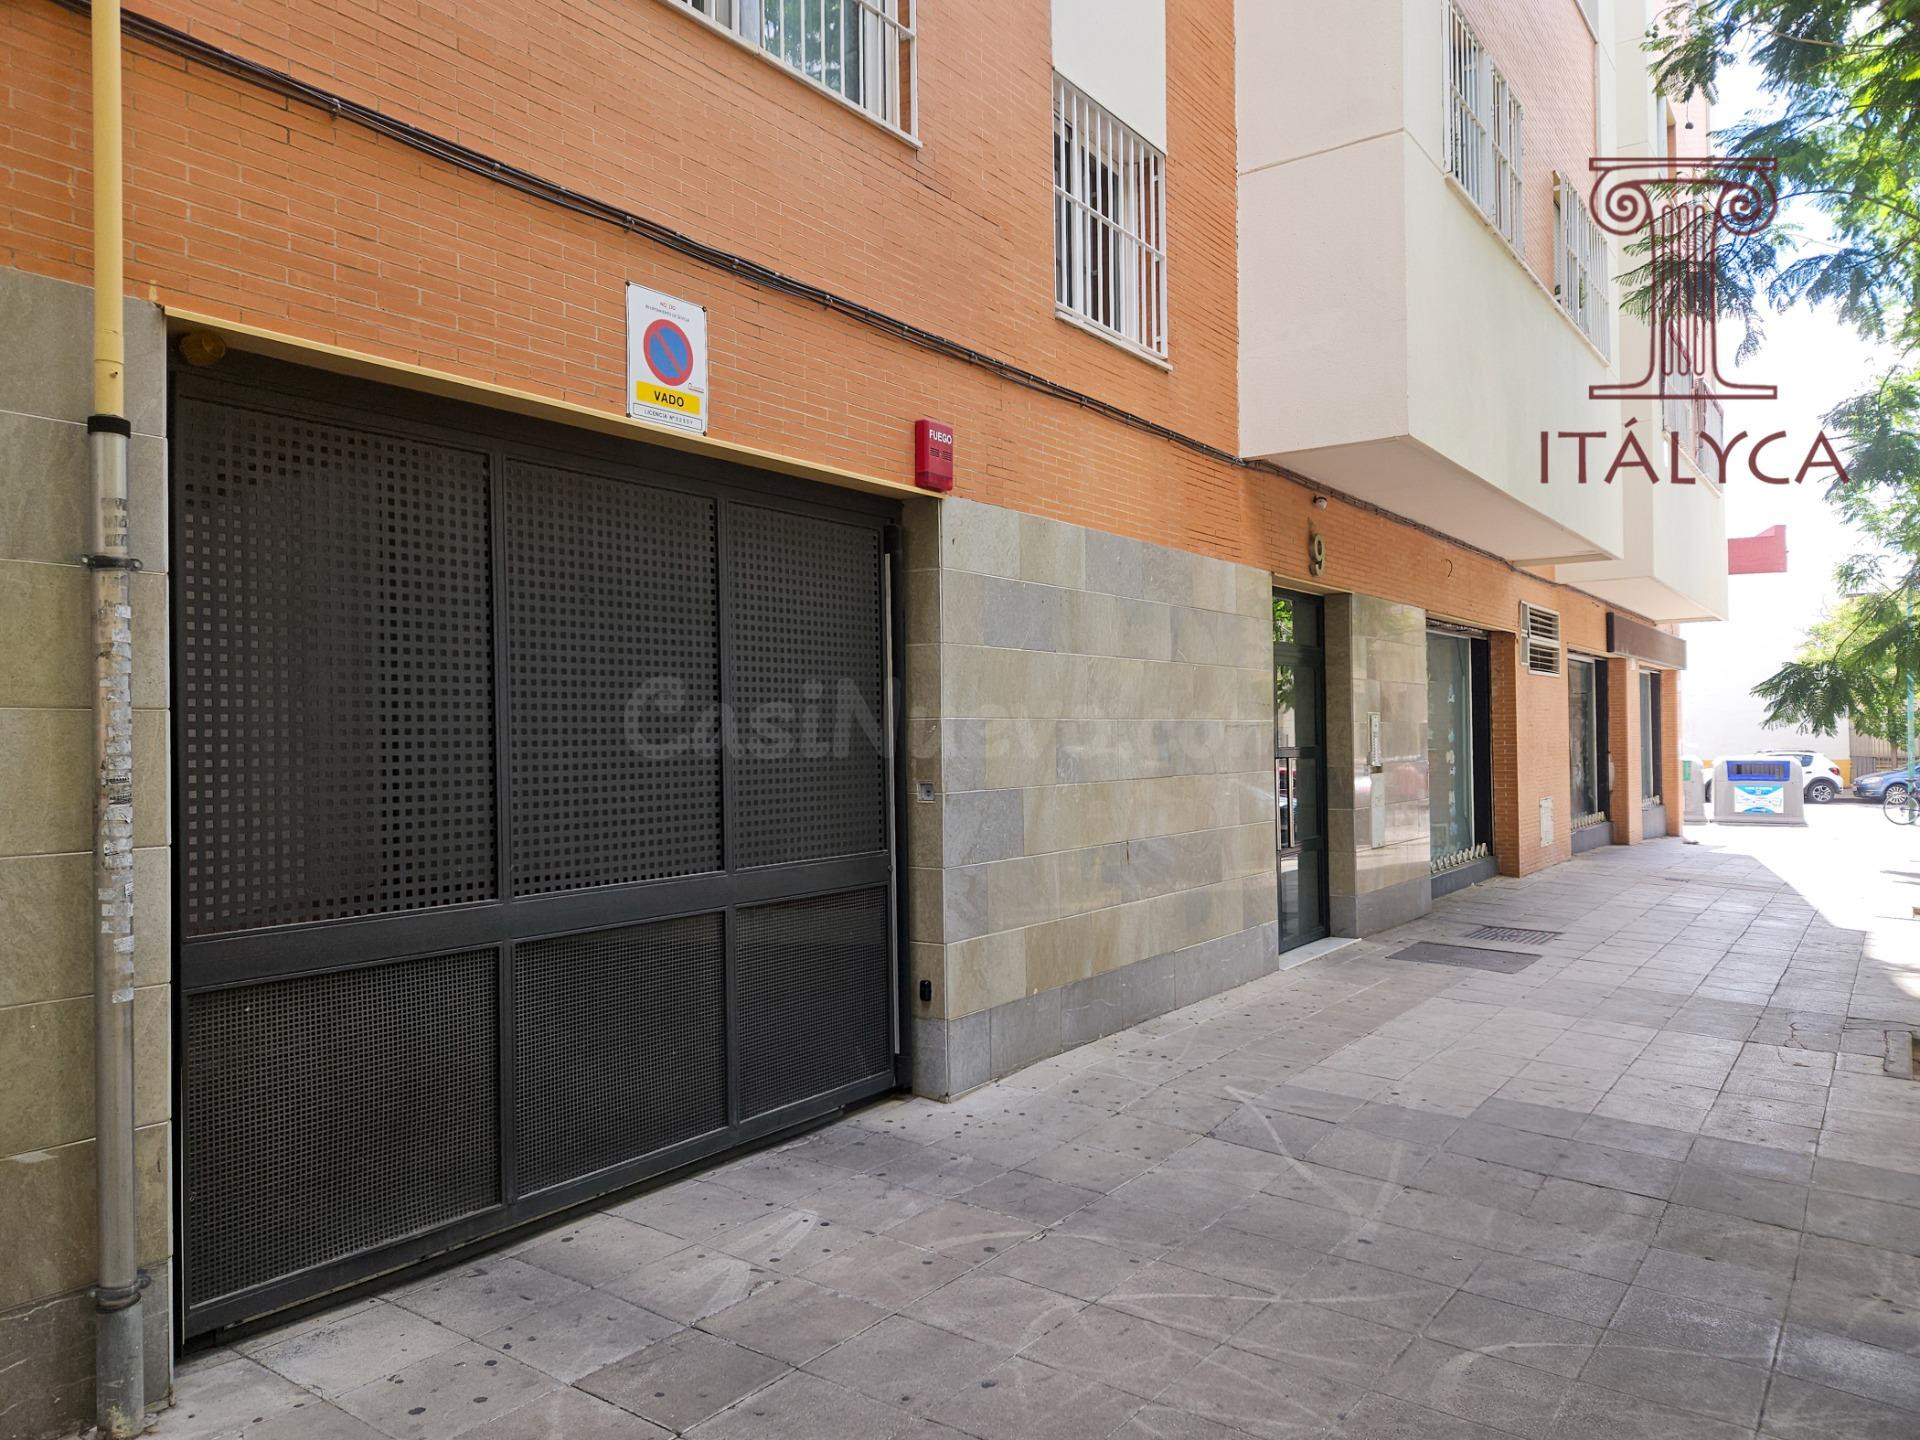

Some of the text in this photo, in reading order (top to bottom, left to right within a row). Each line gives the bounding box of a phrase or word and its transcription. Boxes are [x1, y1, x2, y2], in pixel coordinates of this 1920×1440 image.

[654, 390, 685, 407] VADO
[644, 409, 668, 420] LICENCIA
[929, 429, 952, 445] FUEGO
[1312, 532, 1326, 577] 9
